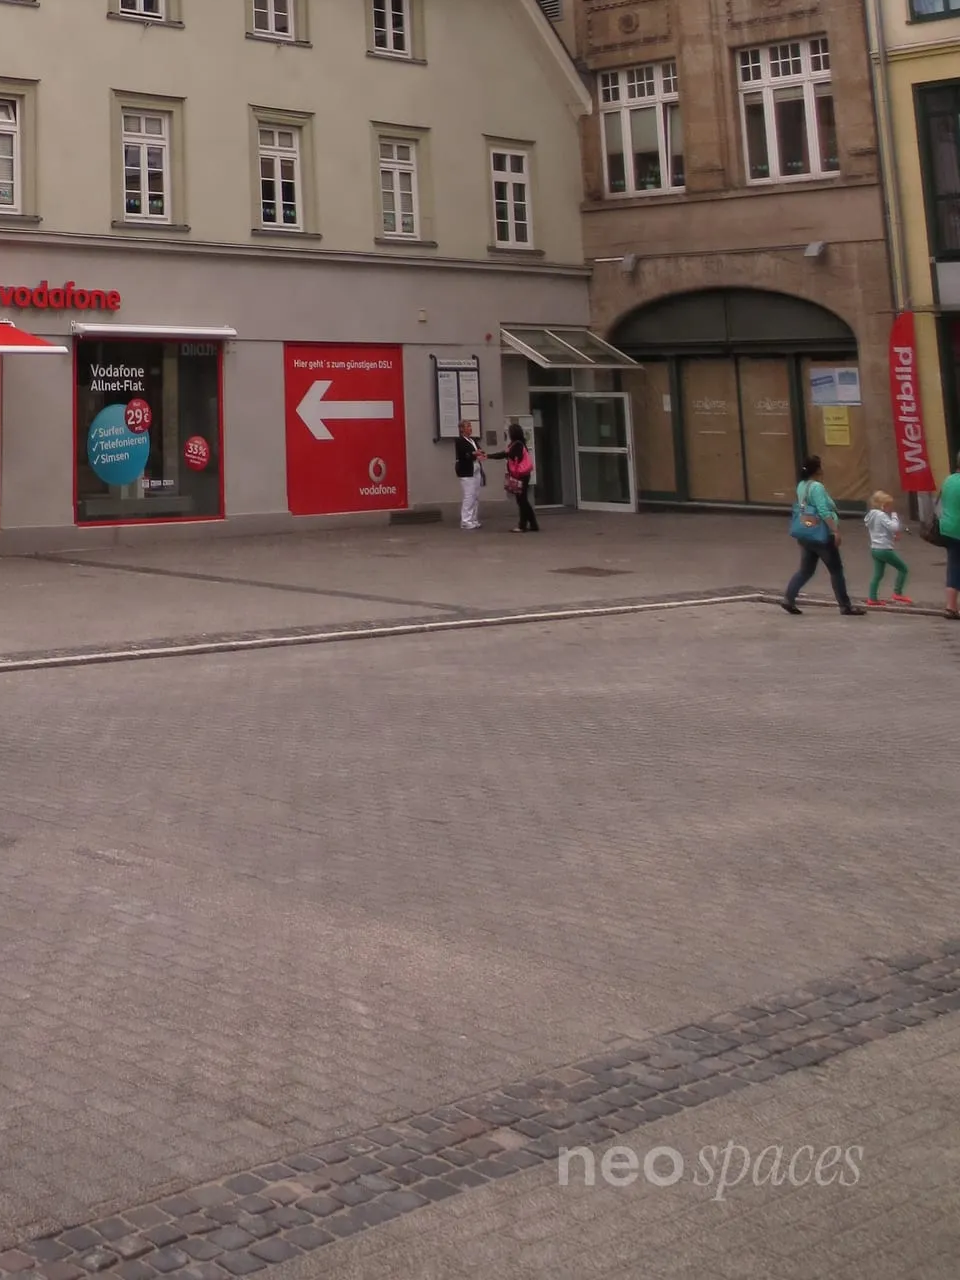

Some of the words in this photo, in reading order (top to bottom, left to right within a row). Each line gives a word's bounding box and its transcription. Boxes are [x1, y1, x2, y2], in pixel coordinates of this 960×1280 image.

[90, 364, 145, 378] Vodafone
[293, 359, 308, 368] Hier
[331, 361, 346, 369] zum
[346, 360, 377, 371] günstigen
[378, 360, 393, 369] DSL!
[90, 380, 145, 392] Allnet-Flat.
[127, 409, 143, 425] 29
[893, 346, 928, 474] Weltbild
[98, 426, 125, 438] Surfen
[100, 435, 148, 451] Telefonieren
[187, 442, 207, 457] 33%
[100, 450, 130, 464] Simsen
[359, 484, 397, 496] vodafone
